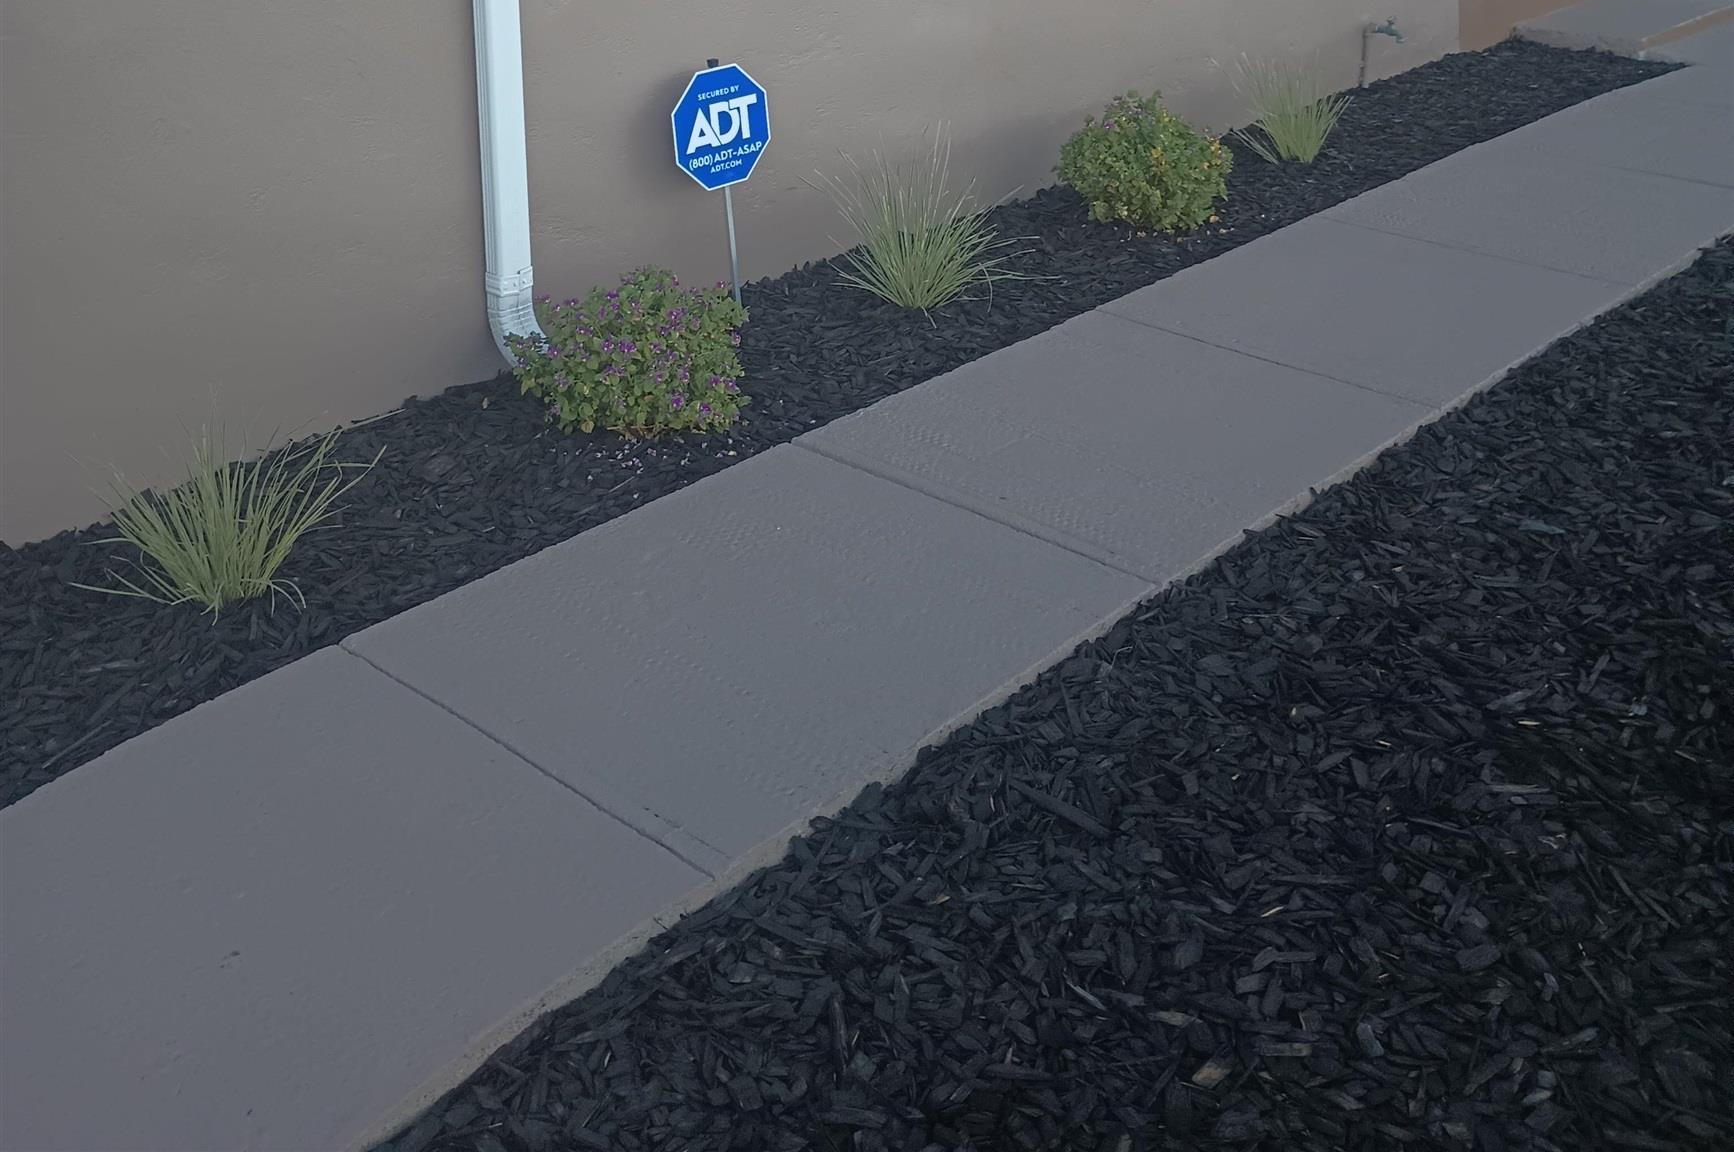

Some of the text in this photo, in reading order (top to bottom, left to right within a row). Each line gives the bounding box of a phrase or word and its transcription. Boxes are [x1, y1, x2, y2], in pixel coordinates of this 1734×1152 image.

[697, 85, 740, 101] SECURED BY
[686, 93, 758, 156] ADT
[688, 141, 762, 171] (800) ADT-ASAP
[710, 159, 742, 174] ADT.COM
